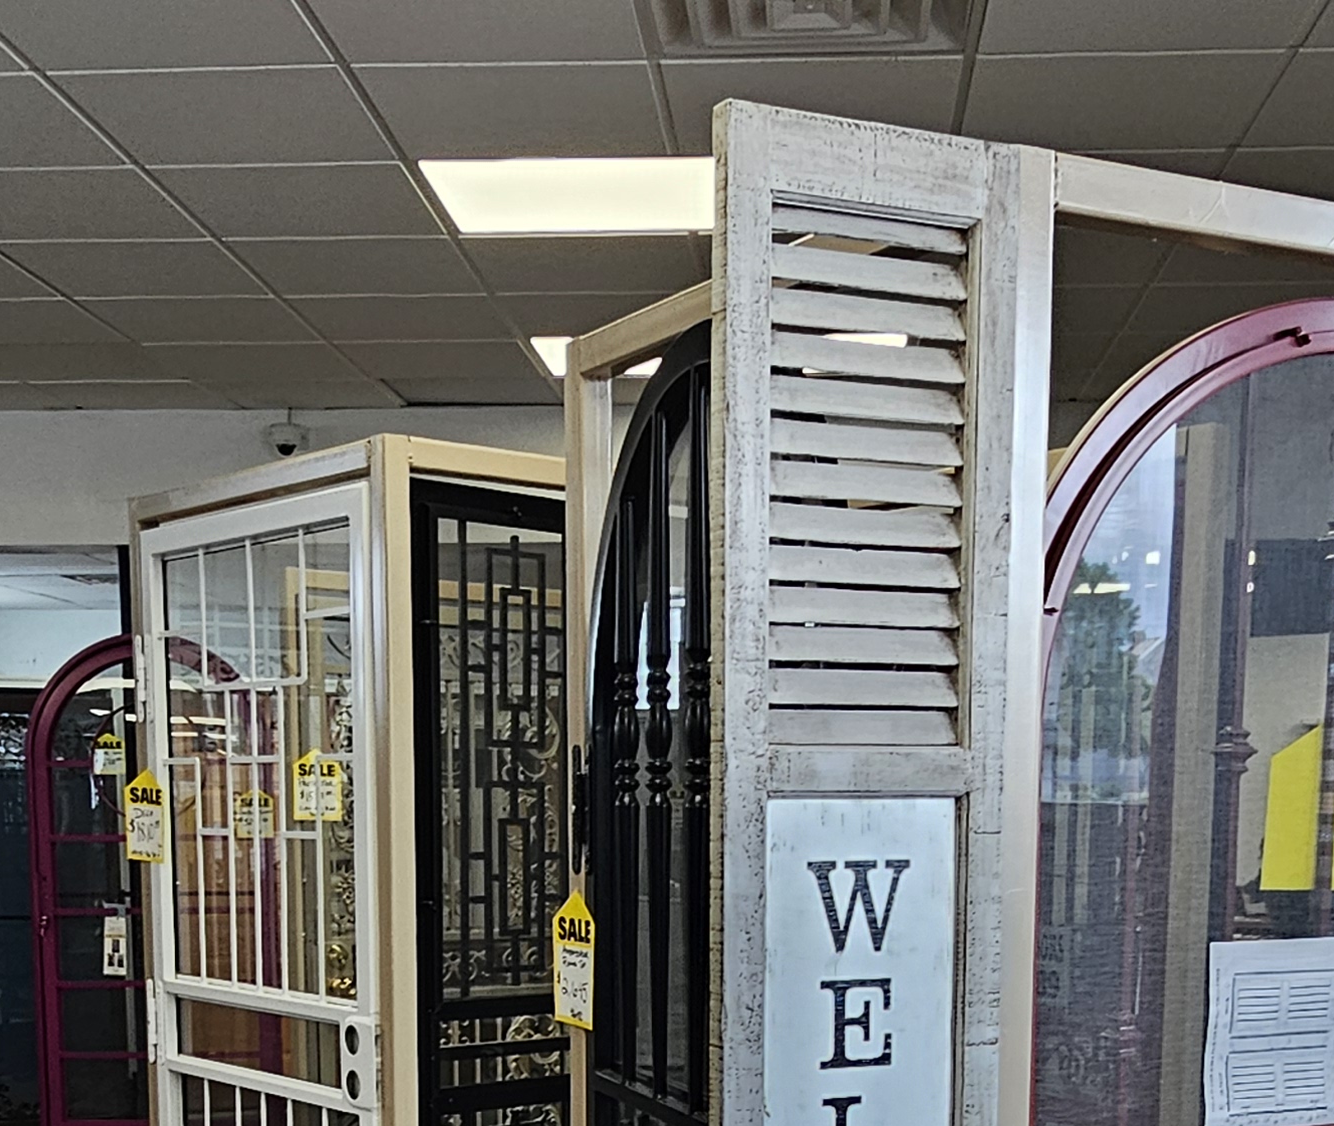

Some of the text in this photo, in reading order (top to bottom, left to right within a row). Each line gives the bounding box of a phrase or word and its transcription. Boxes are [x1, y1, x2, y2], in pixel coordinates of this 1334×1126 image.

[298, 763, 336, 777] SALE
[129, 786, 163, 806] SALE
[557, 915, 592, 944] SALE
